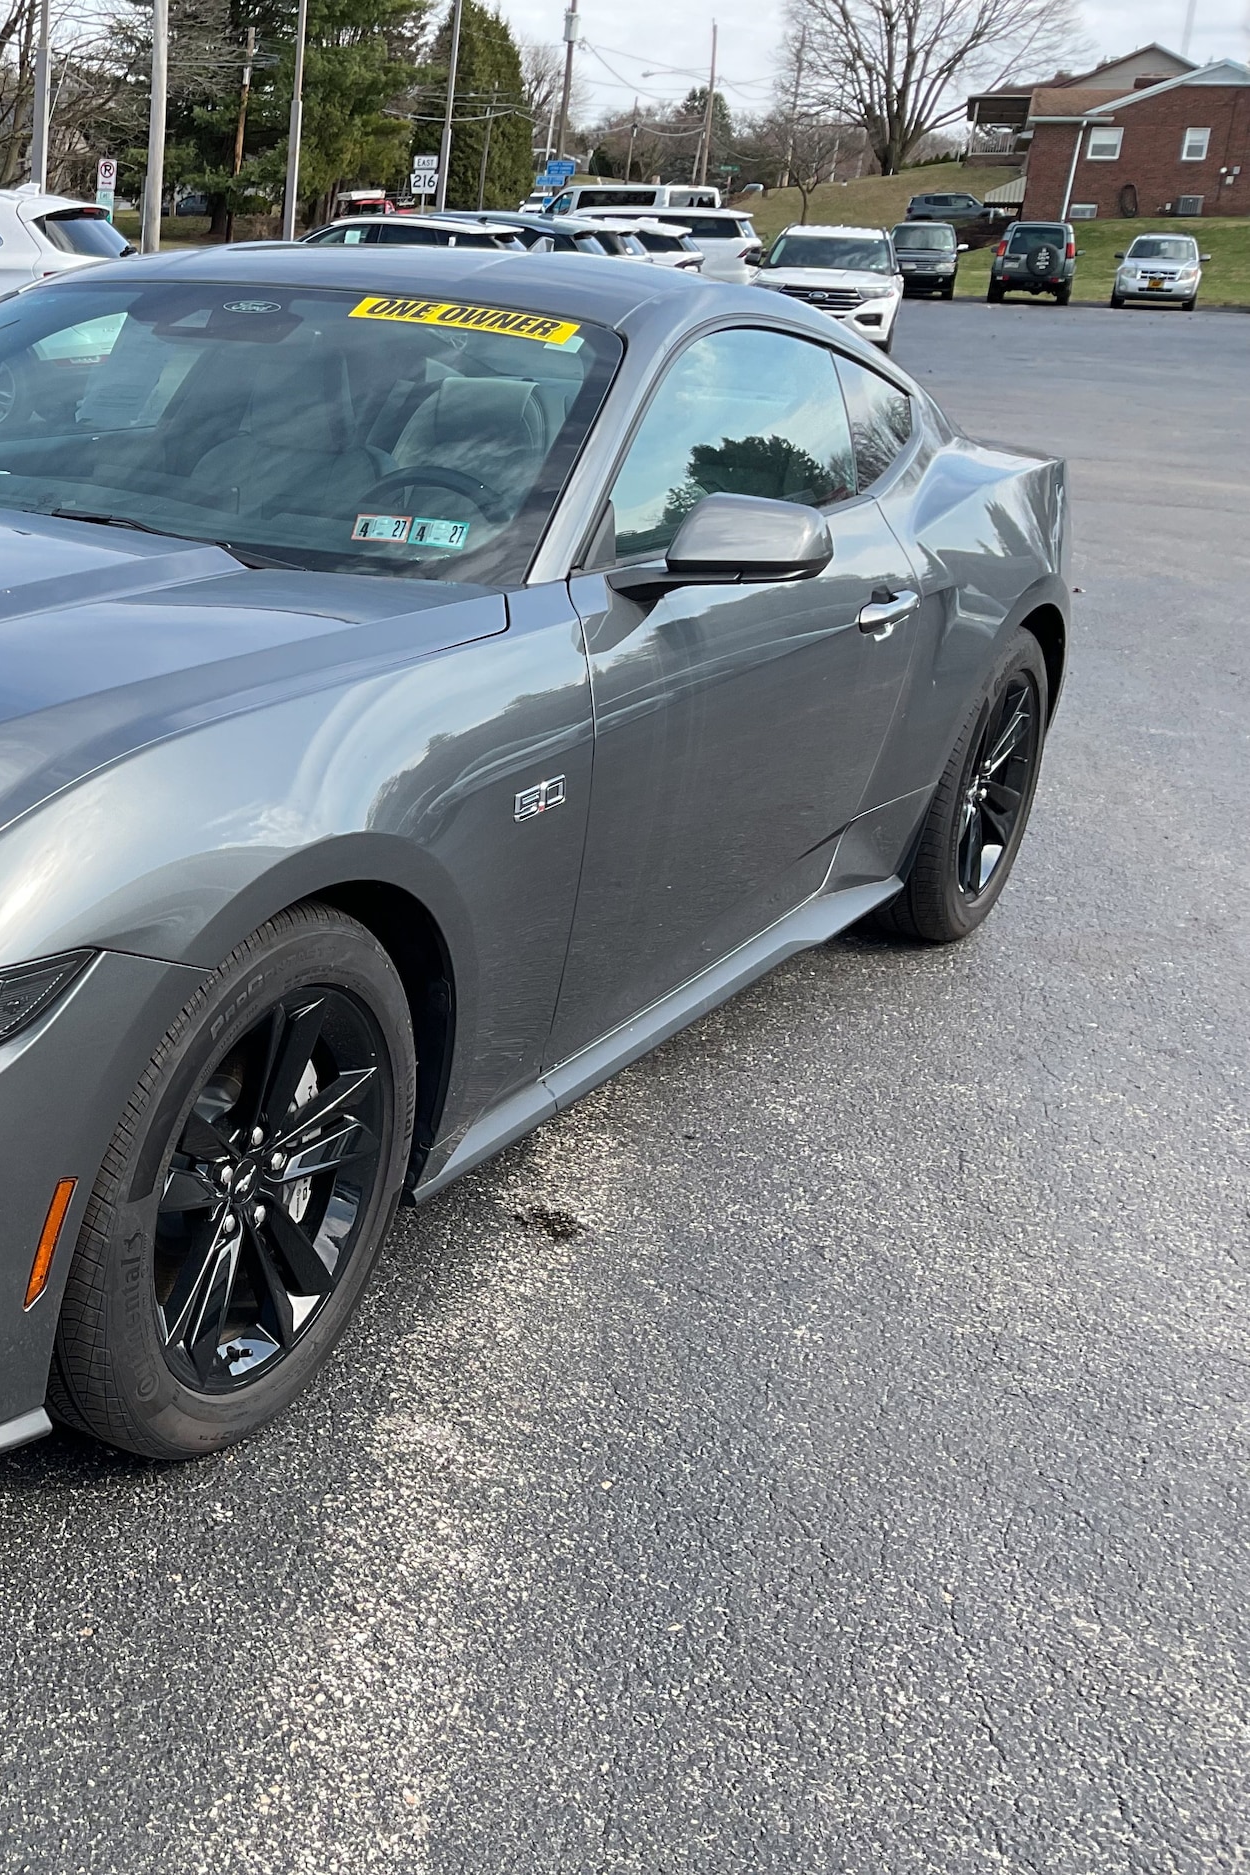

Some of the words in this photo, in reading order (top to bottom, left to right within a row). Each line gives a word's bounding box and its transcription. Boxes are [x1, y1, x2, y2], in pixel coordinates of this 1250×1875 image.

[417, 158, 434, 167] EAST
[413, 174, 435, 188] 216
[366, 299, 439, 320] ONE
[437, 306, 562, 338] OWNER
[358, 522, 370, 538] 4
[392, 520, 407, 539] 27
[414, 526, 427, 542] 4
[448, 525, 465, 545] 27
